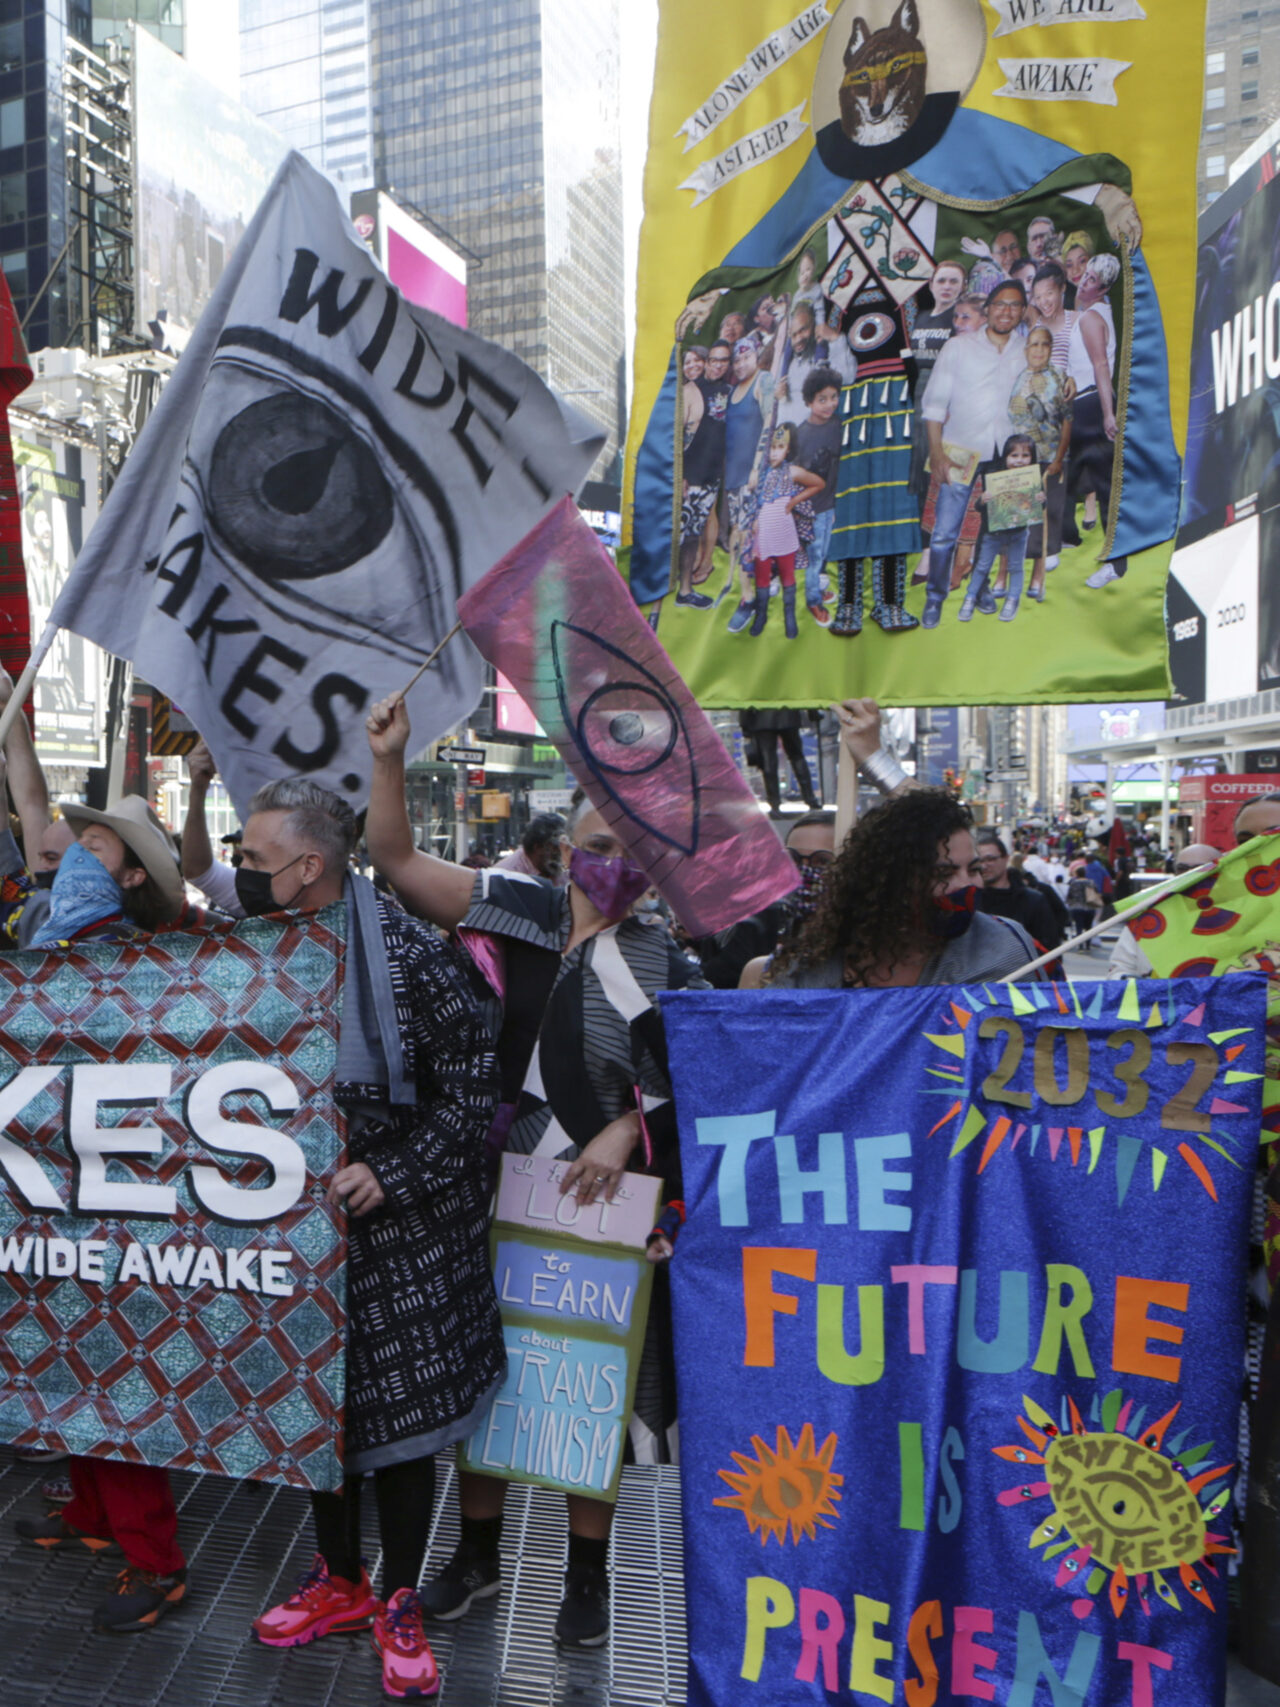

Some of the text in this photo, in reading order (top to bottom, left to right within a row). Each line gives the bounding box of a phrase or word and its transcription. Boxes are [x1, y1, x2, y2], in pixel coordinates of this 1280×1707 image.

[692, 3, 825, 137] ALONE WE ARE
[1014, 63, 1099, 93] AWAKE
[712, 119, 789, 182] ASLEEP
[279, 247, 520, 489] WIDE
[146, 504, 370, 791] AKES.
[1218, 603, 1246, 628] 2020
[977, 1015, 1222, 1134] 2032
[525, 1183, 621, 1235] LOT
[695, 1109, 913, 1232] THE
[120, 1245, 294, 1299] AWAKE
[500, 1266, 631, 1325] LEARN
[541, 1252, 572, 1276] to
[520, 1330, 573, 1354] about
[741, 1245, 1191, 1386] FUTURE
[898, 1422, 965, 1534] IS
[740, 1575, 1173, 1707] PRESENT
